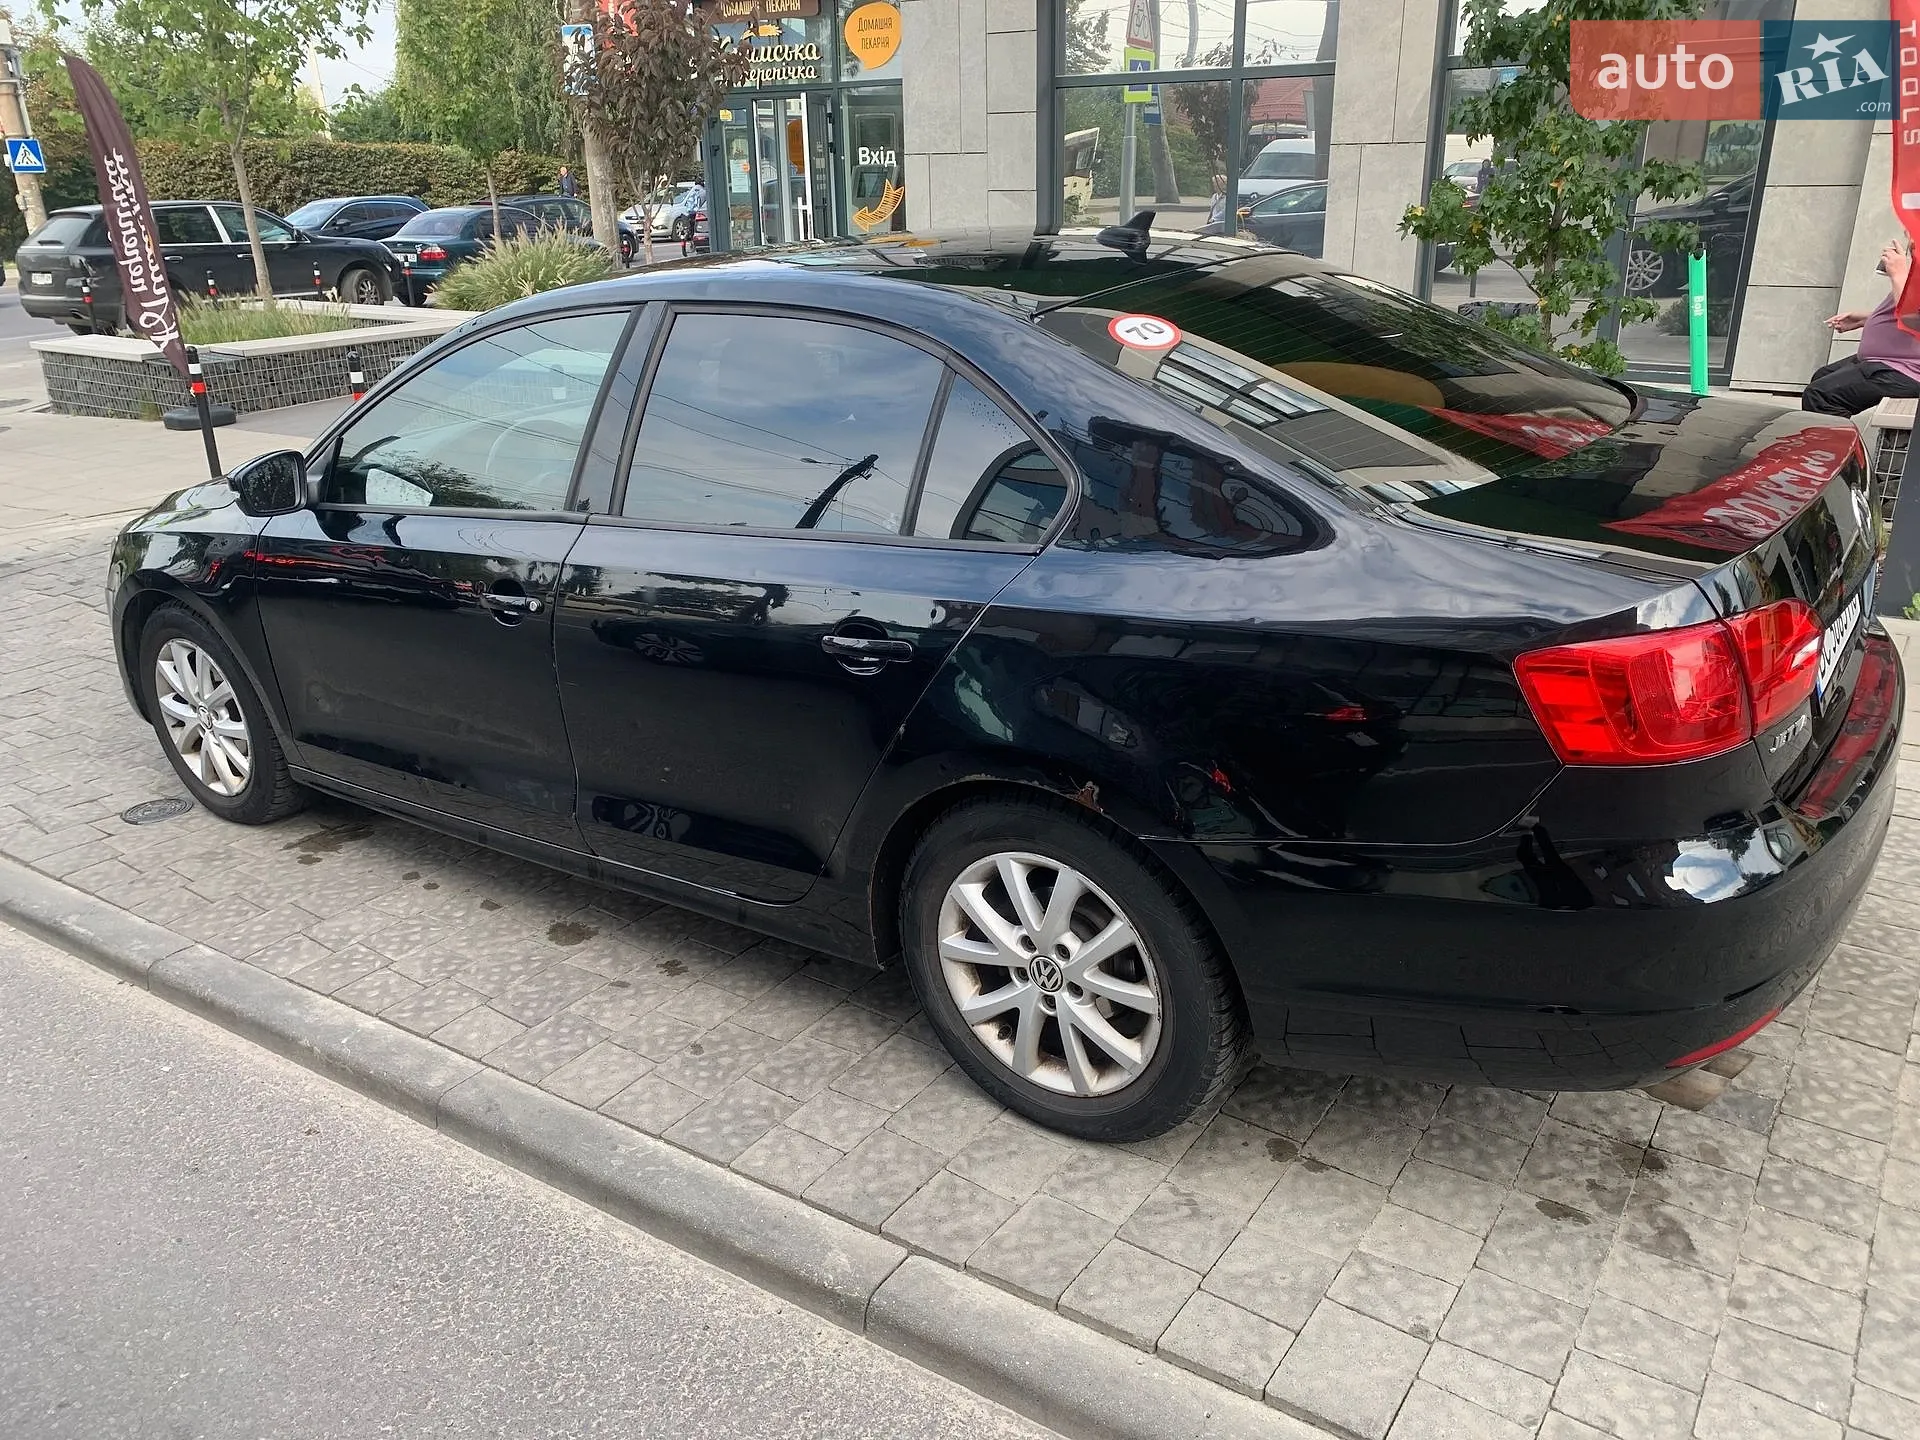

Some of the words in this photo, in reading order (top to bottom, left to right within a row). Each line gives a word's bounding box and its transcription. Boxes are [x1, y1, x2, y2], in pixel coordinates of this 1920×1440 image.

[861, 37, 890, 50] ПЕКАРНЯ
[858, 146, 897, 167] Вхід
[1124, 322, 1165, 340] 70
